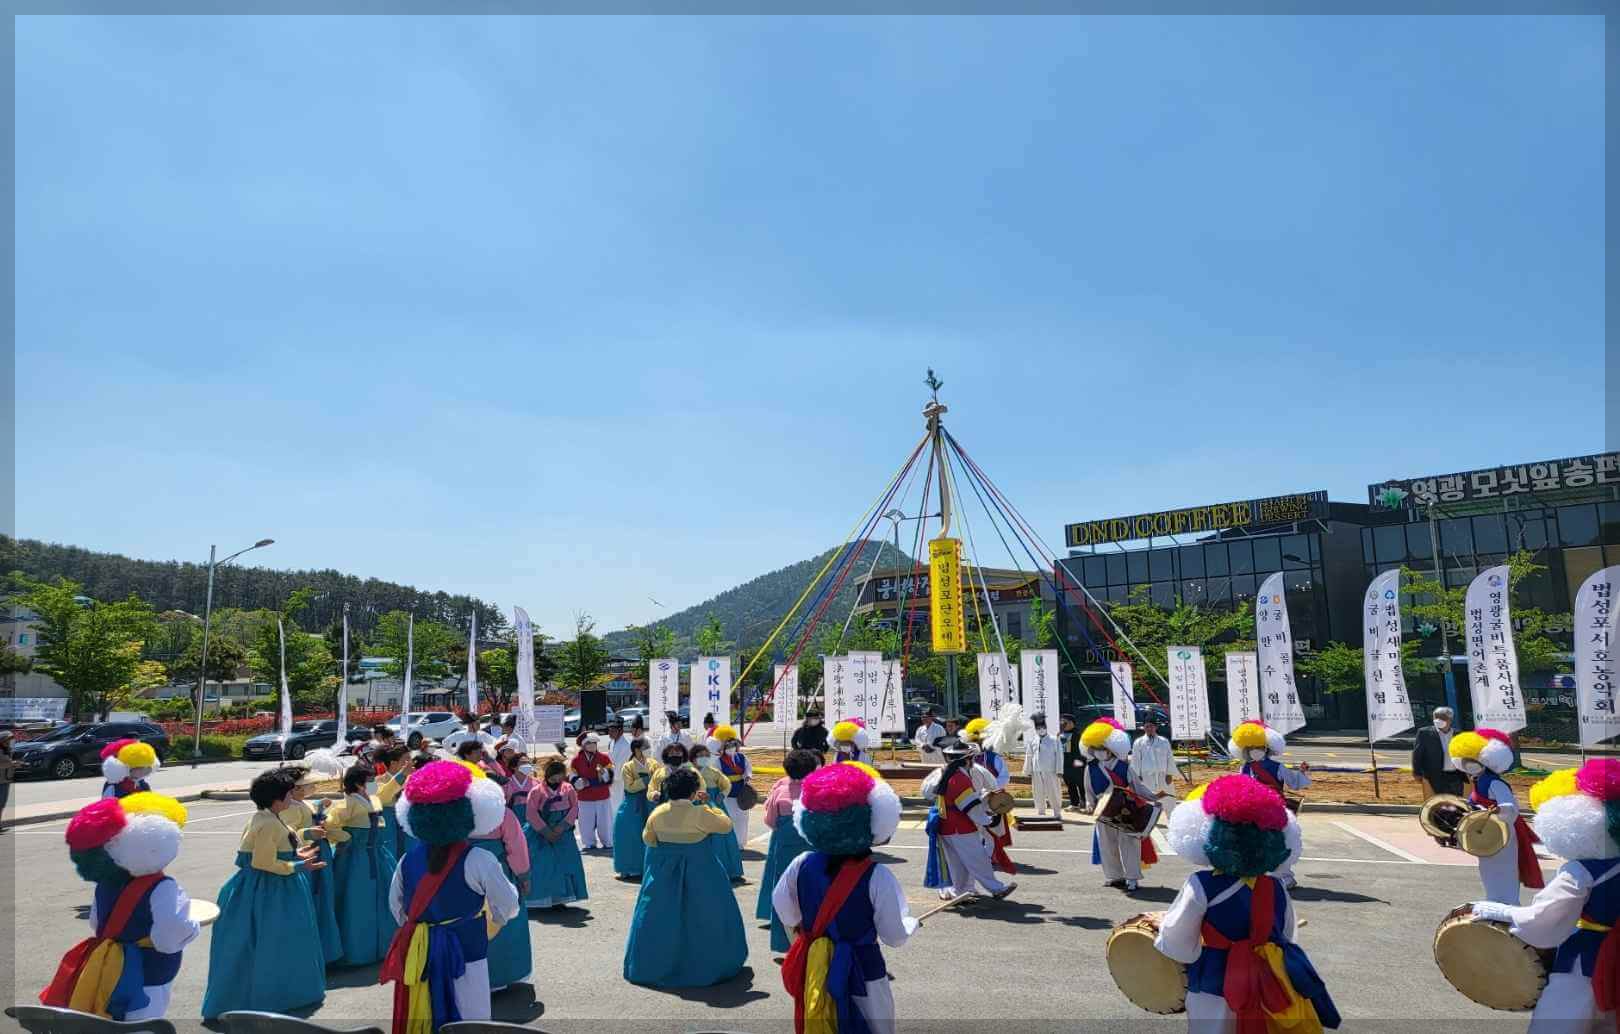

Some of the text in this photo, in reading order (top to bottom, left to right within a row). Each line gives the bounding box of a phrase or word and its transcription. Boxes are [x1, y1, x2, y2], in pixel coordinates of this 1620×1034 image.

[1411, 476, 1466, 505] 영광
[1071, 503, 1250, 545] DND COFFEE
[1471, 608, 1490, 688] 법성면어촌계
[868, 670, 878, 730] 법성면
